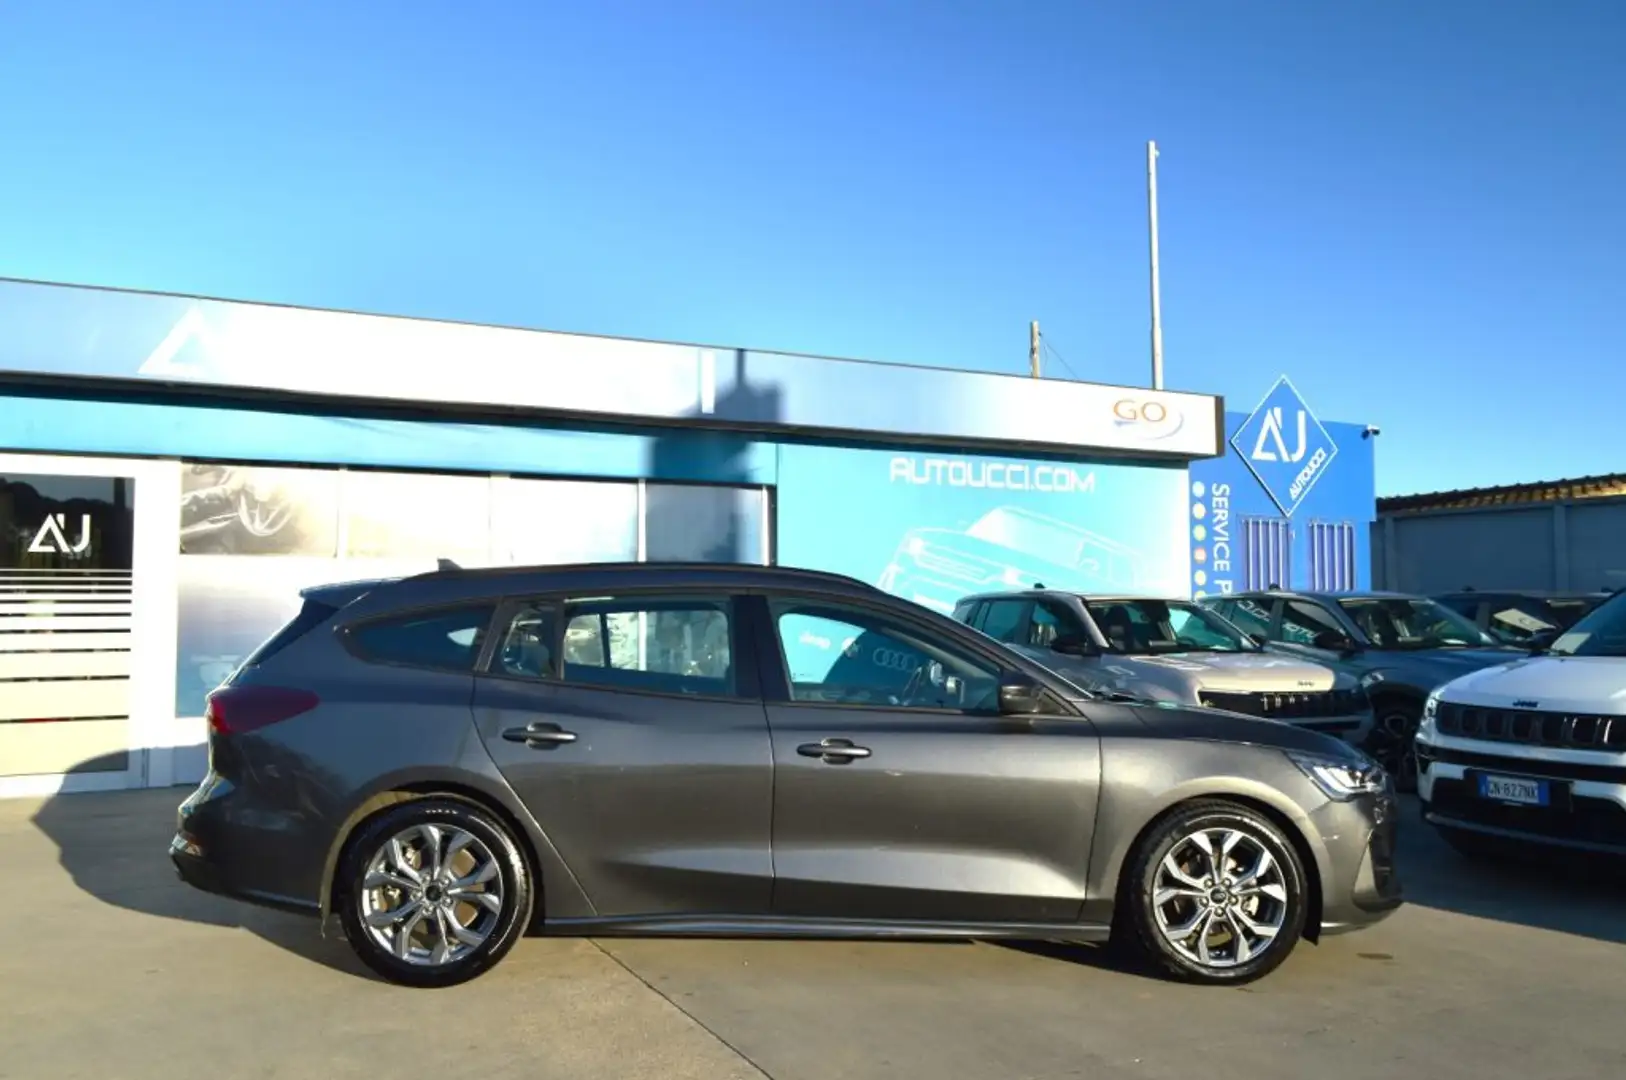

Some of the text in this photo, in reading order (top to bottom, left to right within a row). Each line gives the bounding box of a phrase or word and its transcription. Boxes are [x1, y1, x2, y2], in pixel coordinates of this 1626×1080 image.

[1113, 399, 1167, 422] GO
[889, 457, 1096, 492] AUTOUCCI.COM
[1211, 482, 1231, 573] SERVICE
